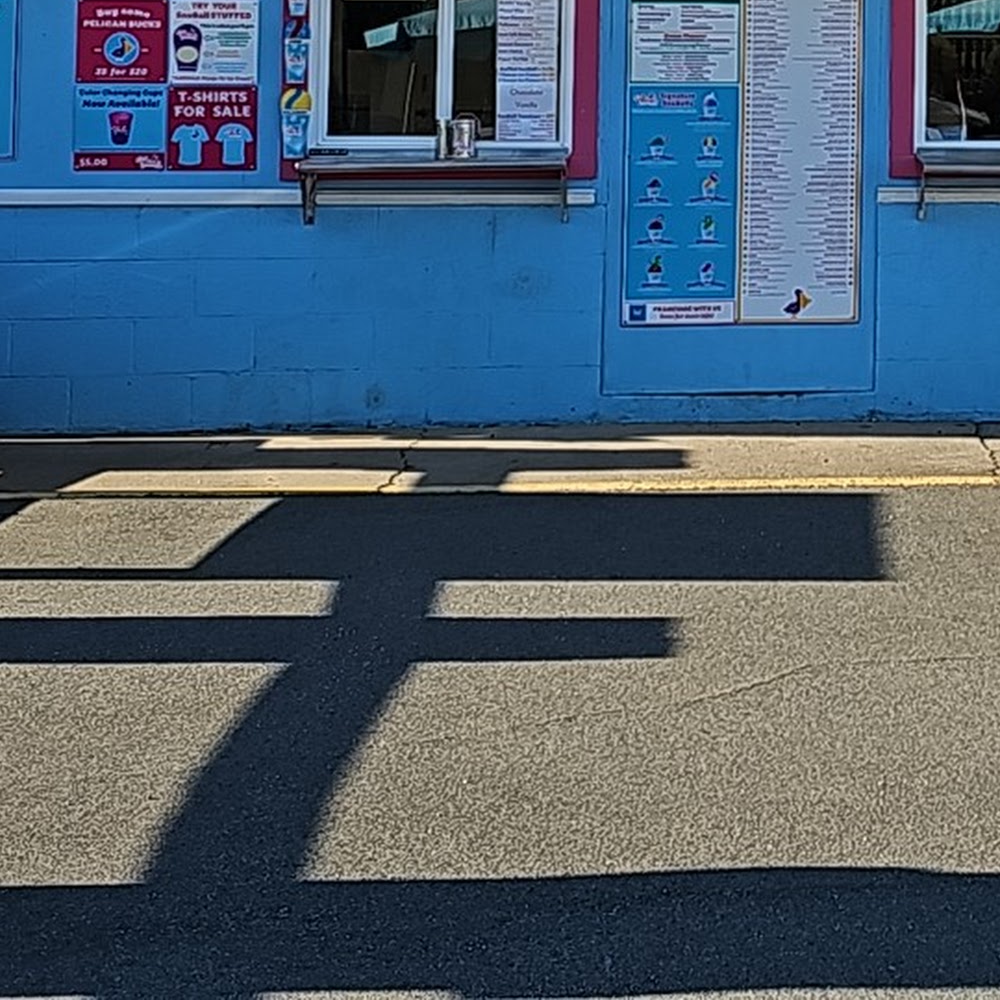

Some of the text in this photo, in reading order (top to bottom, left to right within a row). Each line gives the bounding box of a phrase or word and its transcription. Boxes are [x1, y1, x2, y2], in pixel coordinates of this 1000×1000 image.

[83, 20, 162, 28] PELICAN BUCKS
[178, 91, 248, 103] T-SHIRTS
[174, 106, 250, 117] FOR SALE
